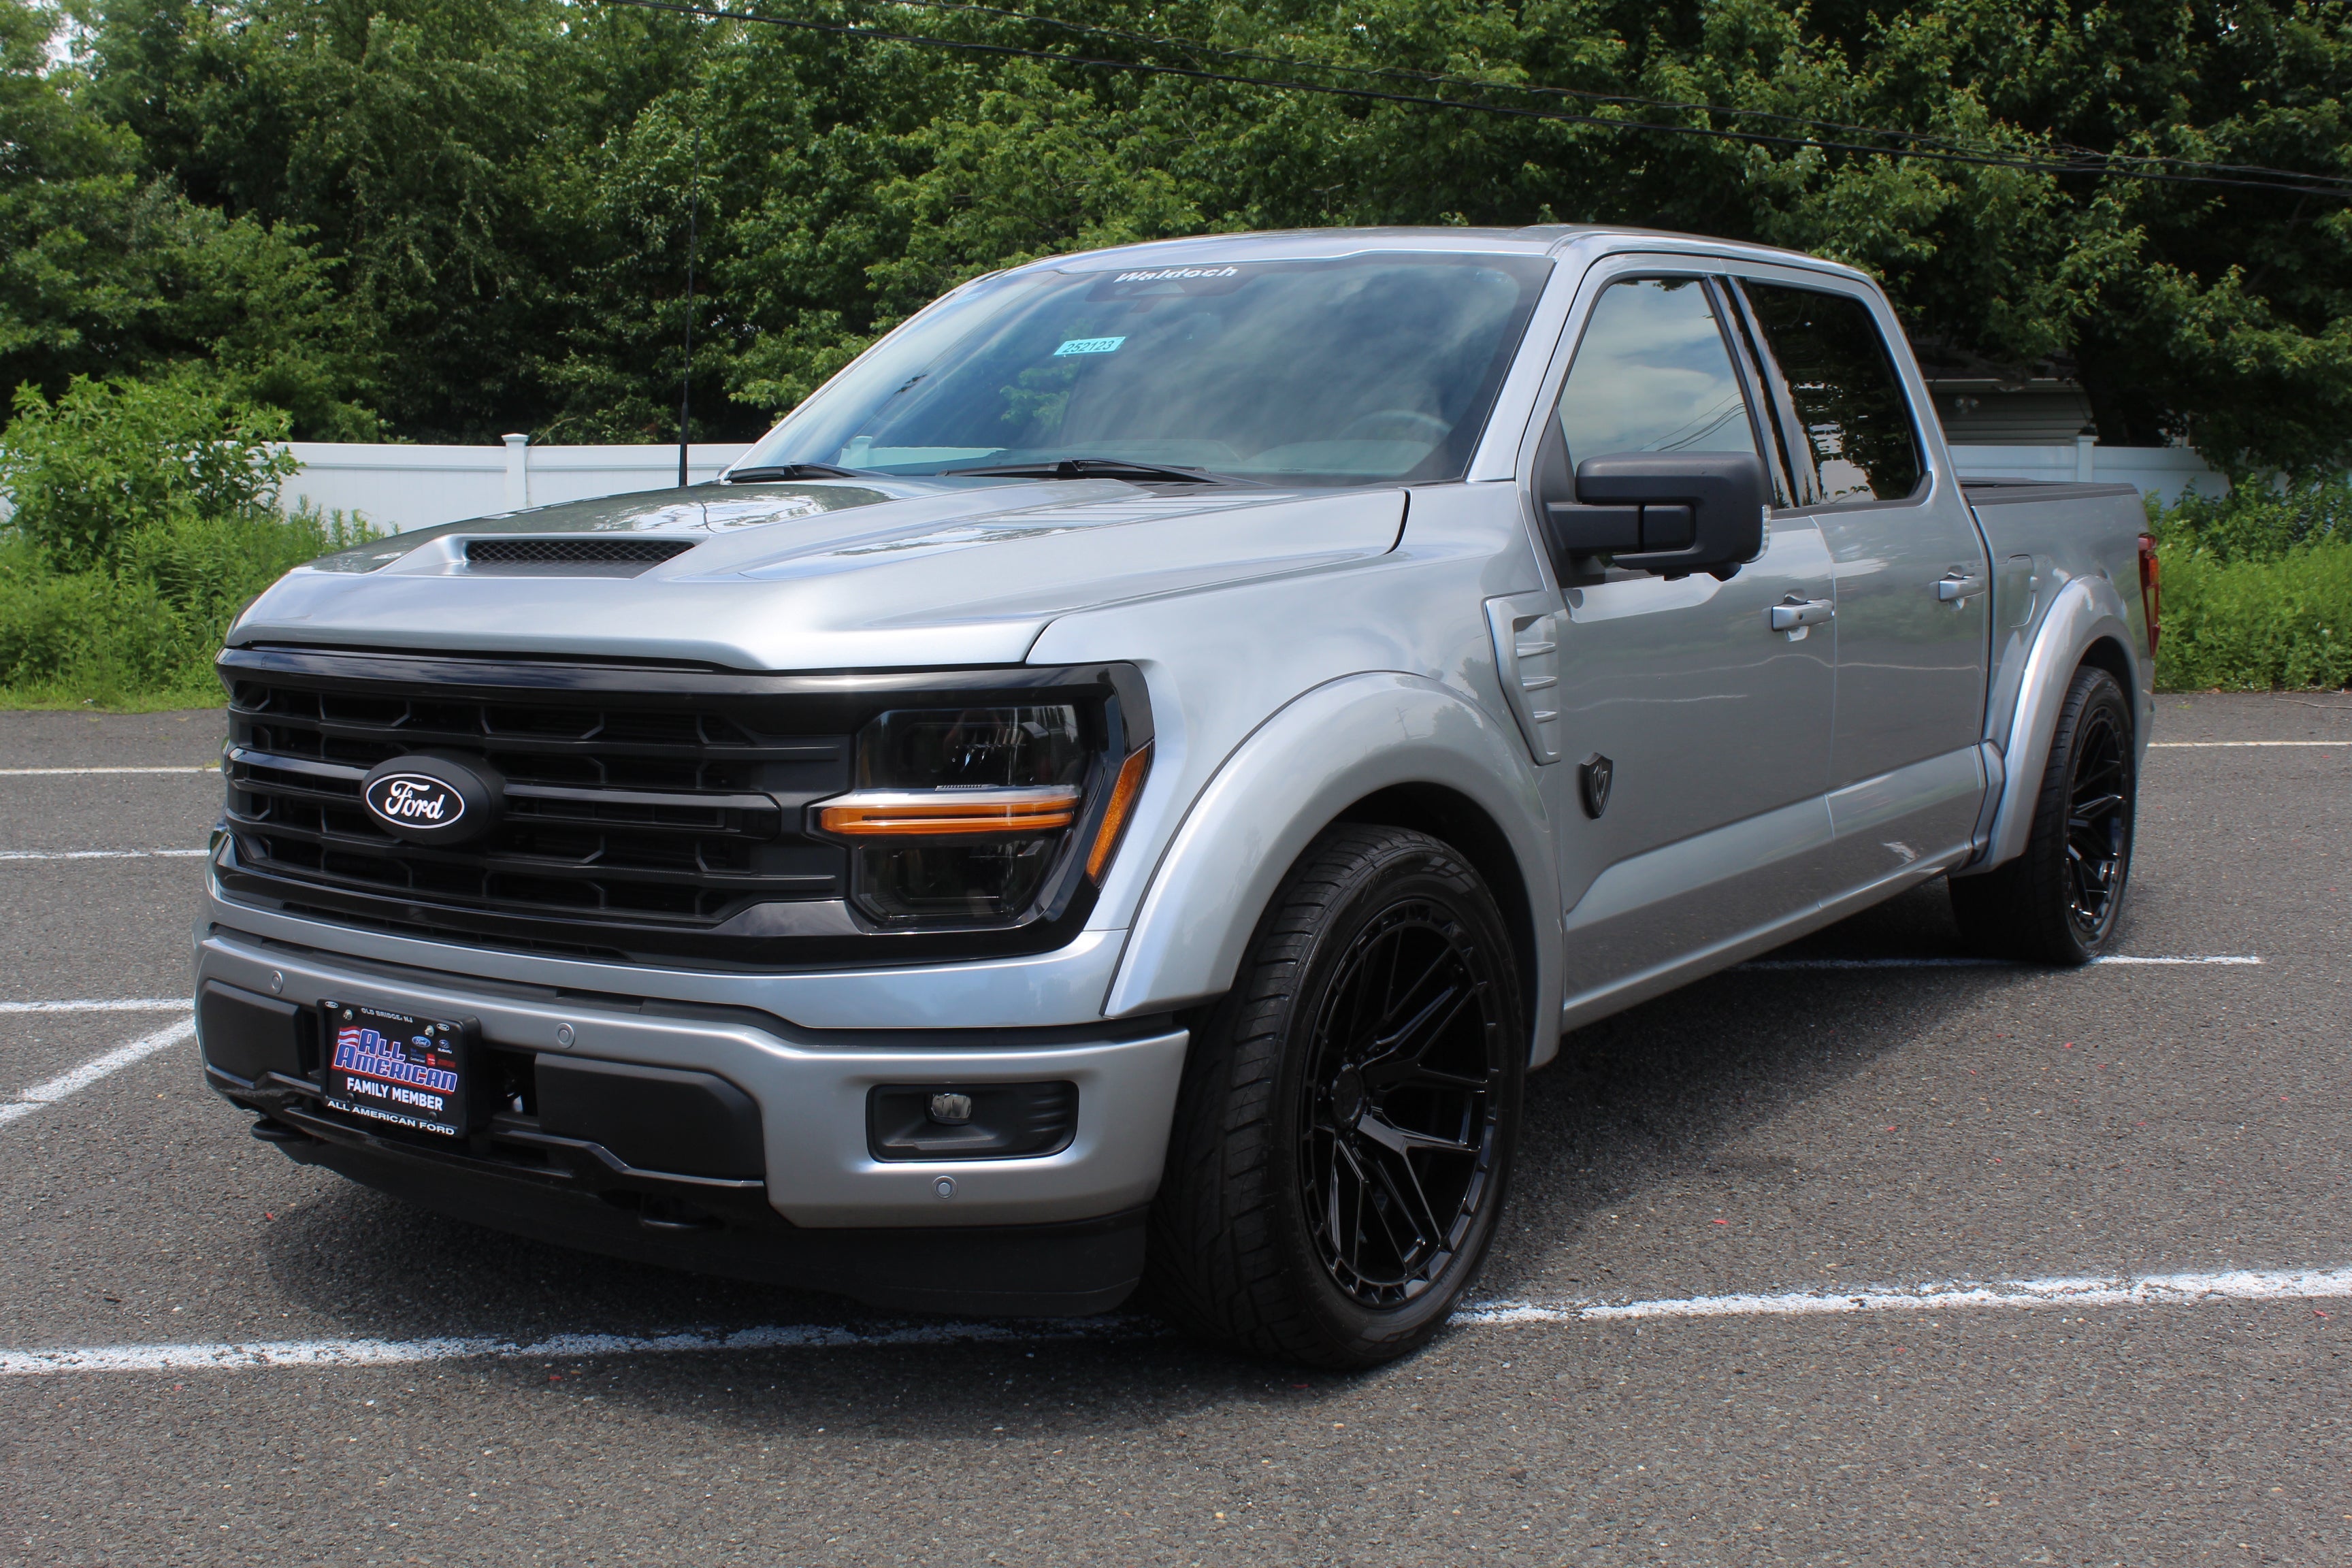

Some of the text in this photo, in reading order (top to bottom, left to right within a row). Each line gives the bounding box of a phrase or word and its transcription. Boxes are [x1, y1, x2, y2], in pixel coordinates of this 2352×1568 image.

[1113, 266, 1239, 283] Waldoch
[1062, 340, 1115, 353] 252123
[385, 780, 445, 819] Ford
[361, 1007, 374, 1015] OLD
[404, 1015, 413, 1024] NJ
[346, 1077, 443, 1111] FAMILY MEMBER
[327, 1100, 455, 1135] ALL AMERICAN FORD
